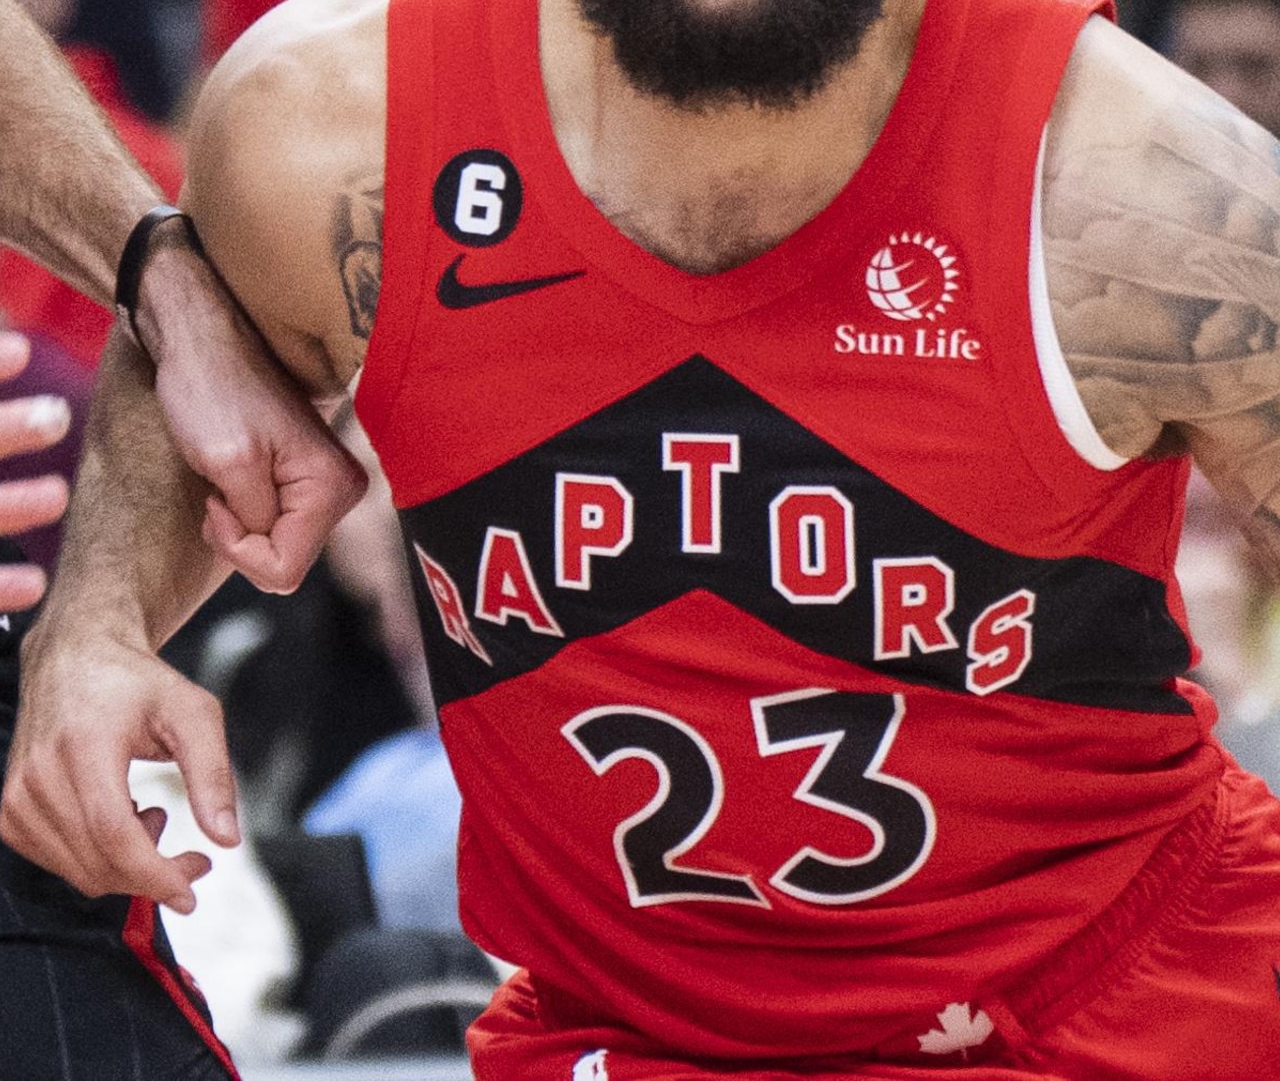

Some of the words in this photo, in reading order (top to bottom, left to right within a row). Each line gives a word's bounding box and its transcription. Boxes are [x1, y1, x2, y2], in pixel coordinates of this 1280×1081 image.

[453, 162, 507, 237] 6
[834, 323, 905, 357] Sun
[915, 327, 982, 361] Life
[412, 431, 1037, 697] RAPTORS
[560, 687, 938, 911] 23
